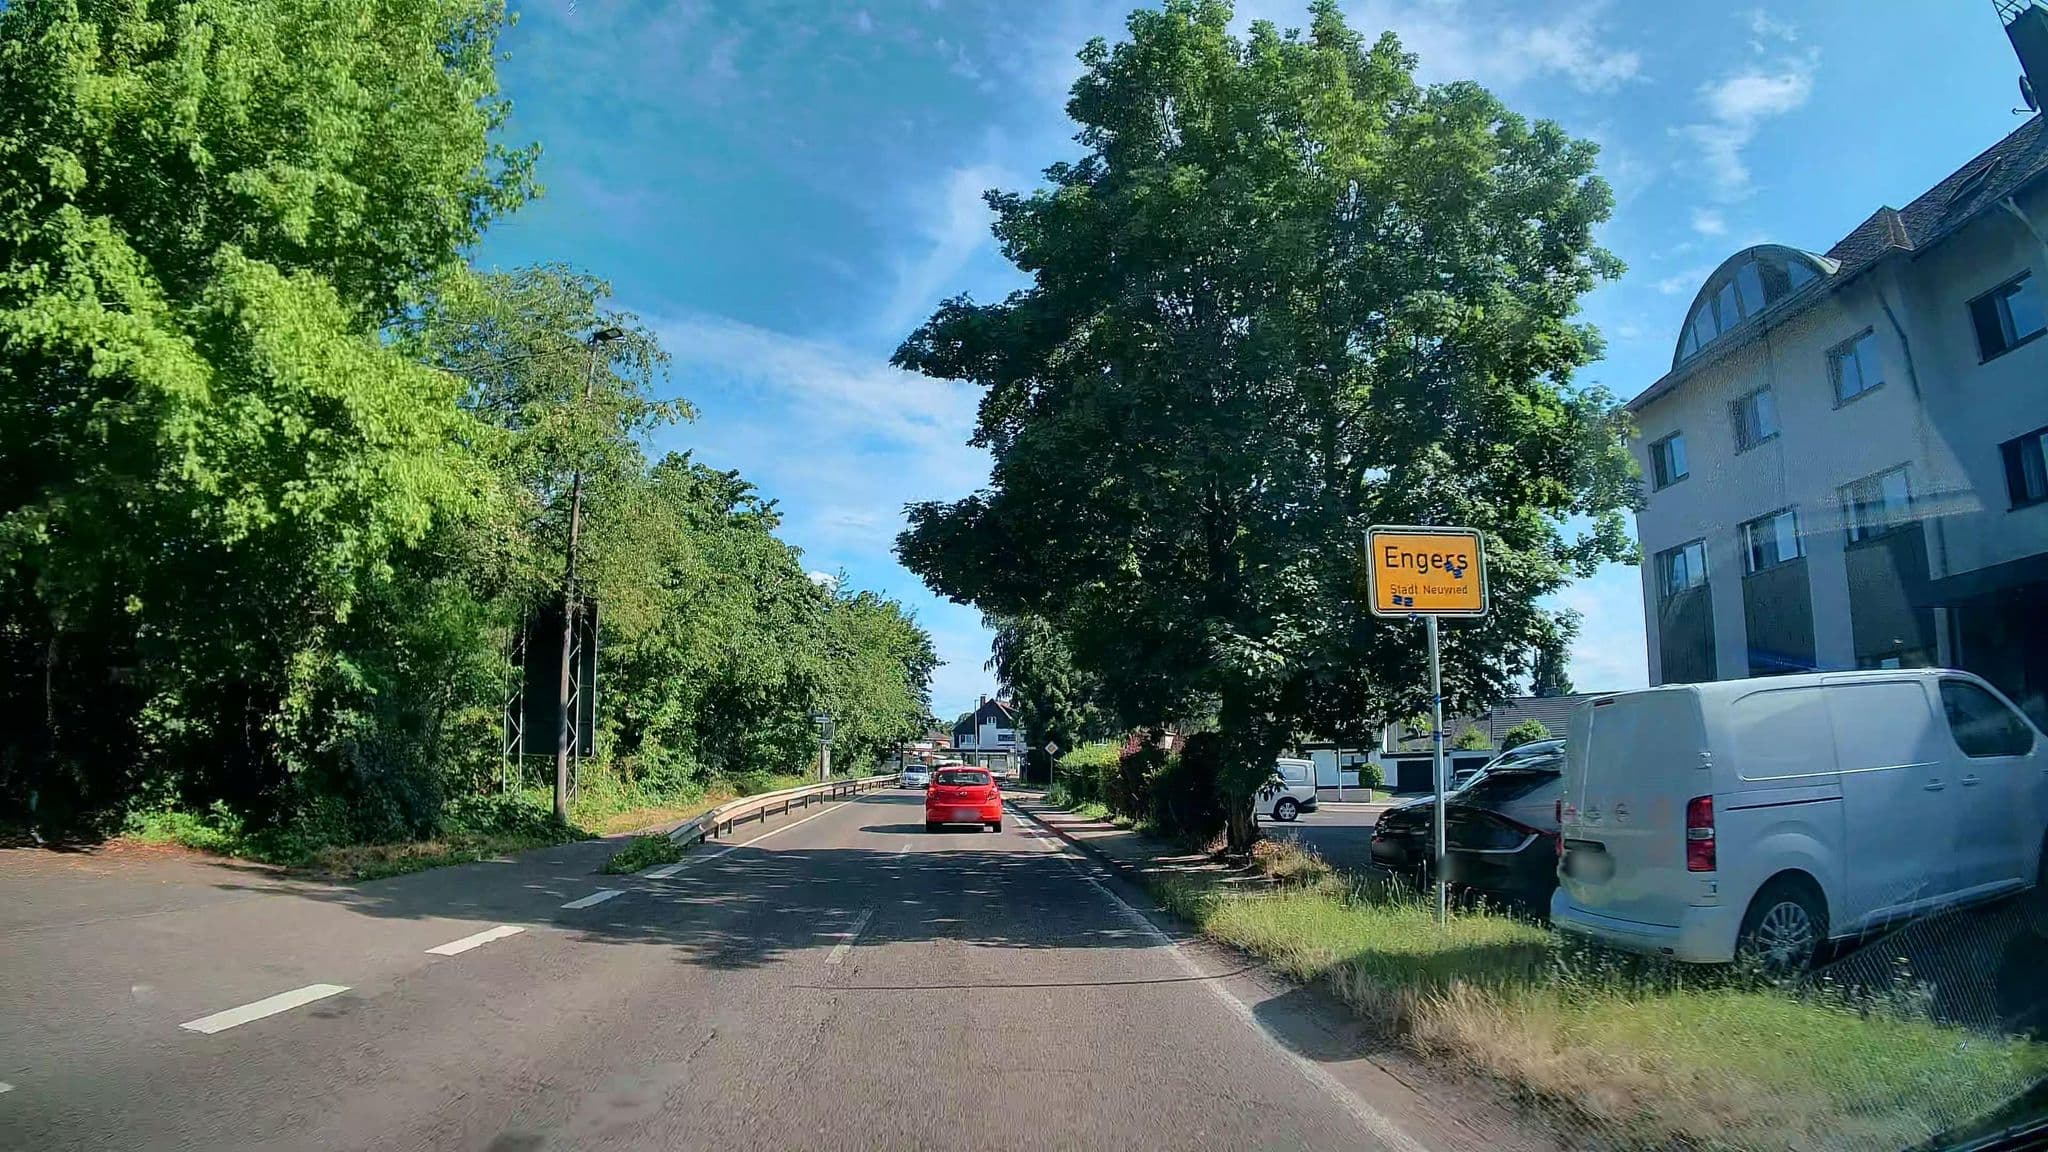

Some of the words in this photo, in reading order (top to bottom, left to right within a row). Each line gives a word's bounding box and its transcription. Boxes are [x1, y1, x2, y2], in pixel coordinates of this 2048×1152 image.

[1385, 546, 1468, 574] Engers
[1390, 584, 1418, 595] Stadt
[1423, 584, 1468, 595] Neuwied
